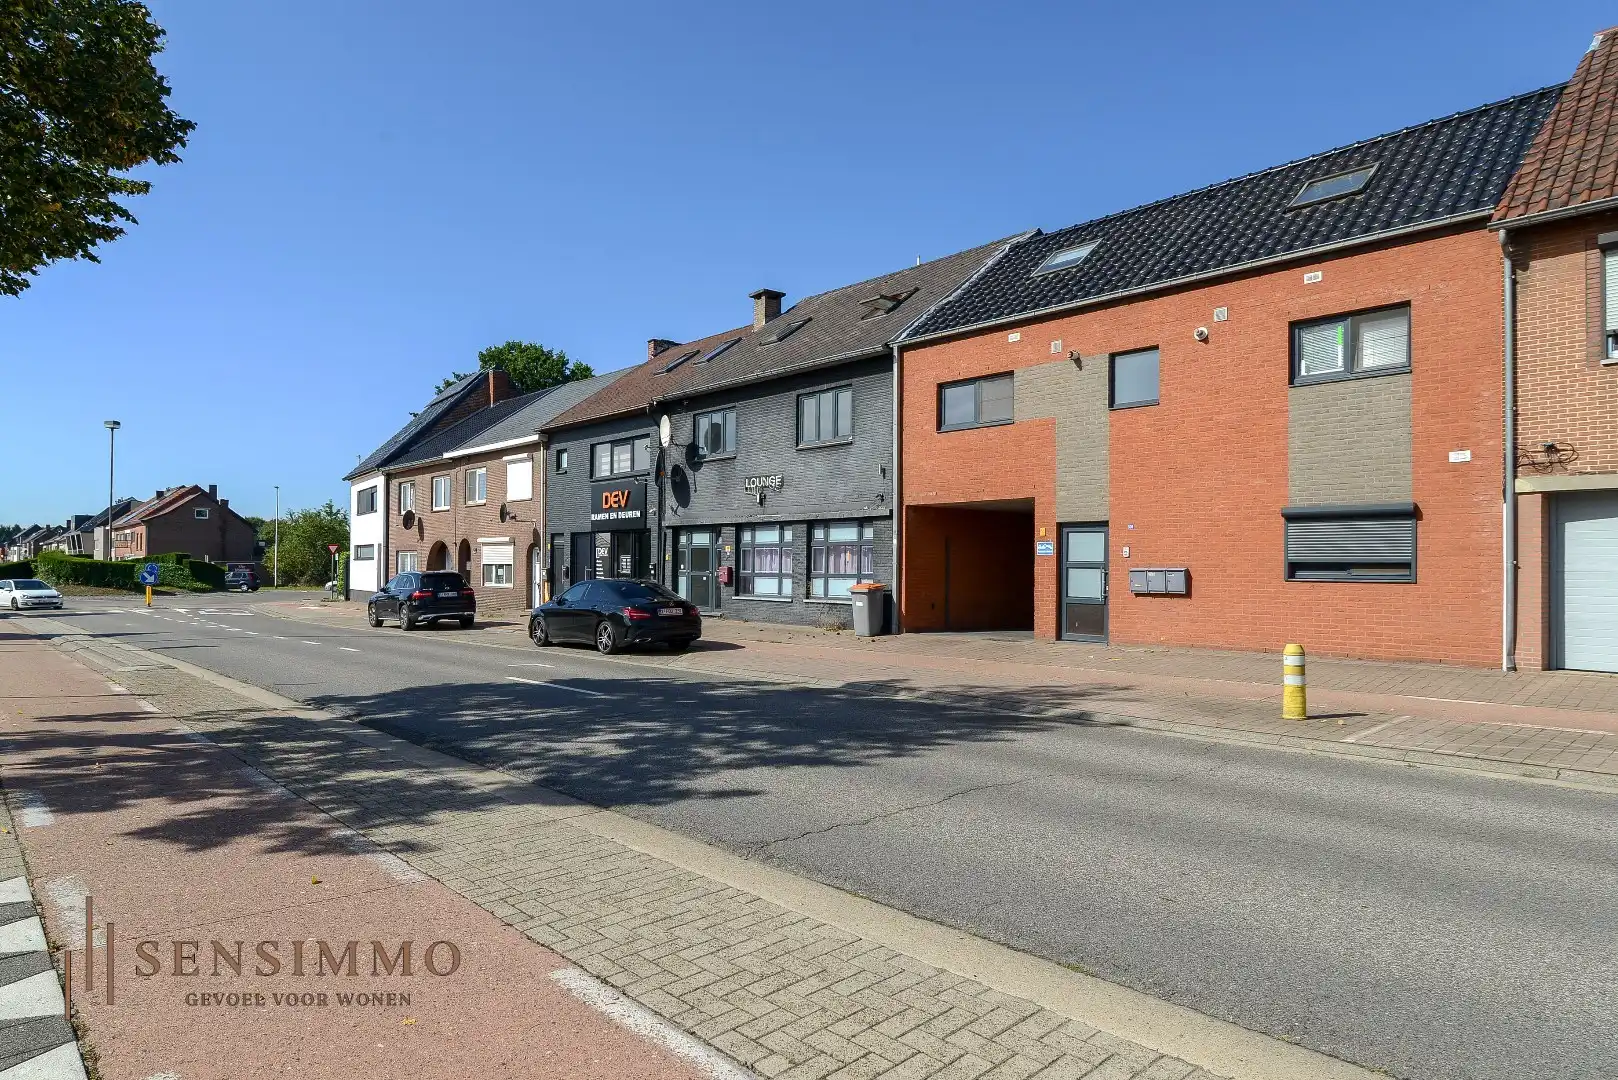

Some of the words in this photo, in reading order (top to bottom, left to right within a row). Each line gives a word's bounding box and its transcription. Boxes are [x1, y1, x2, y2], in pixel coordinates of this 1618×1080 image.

[745, 475, 782, 488] LOUNGE
[602, 489, 629, 509] DEV
[591, 512, 609, 521] RAMEN
[609, 512, 618, 520] EN
[617, 510, 641, 519] DEUREN
